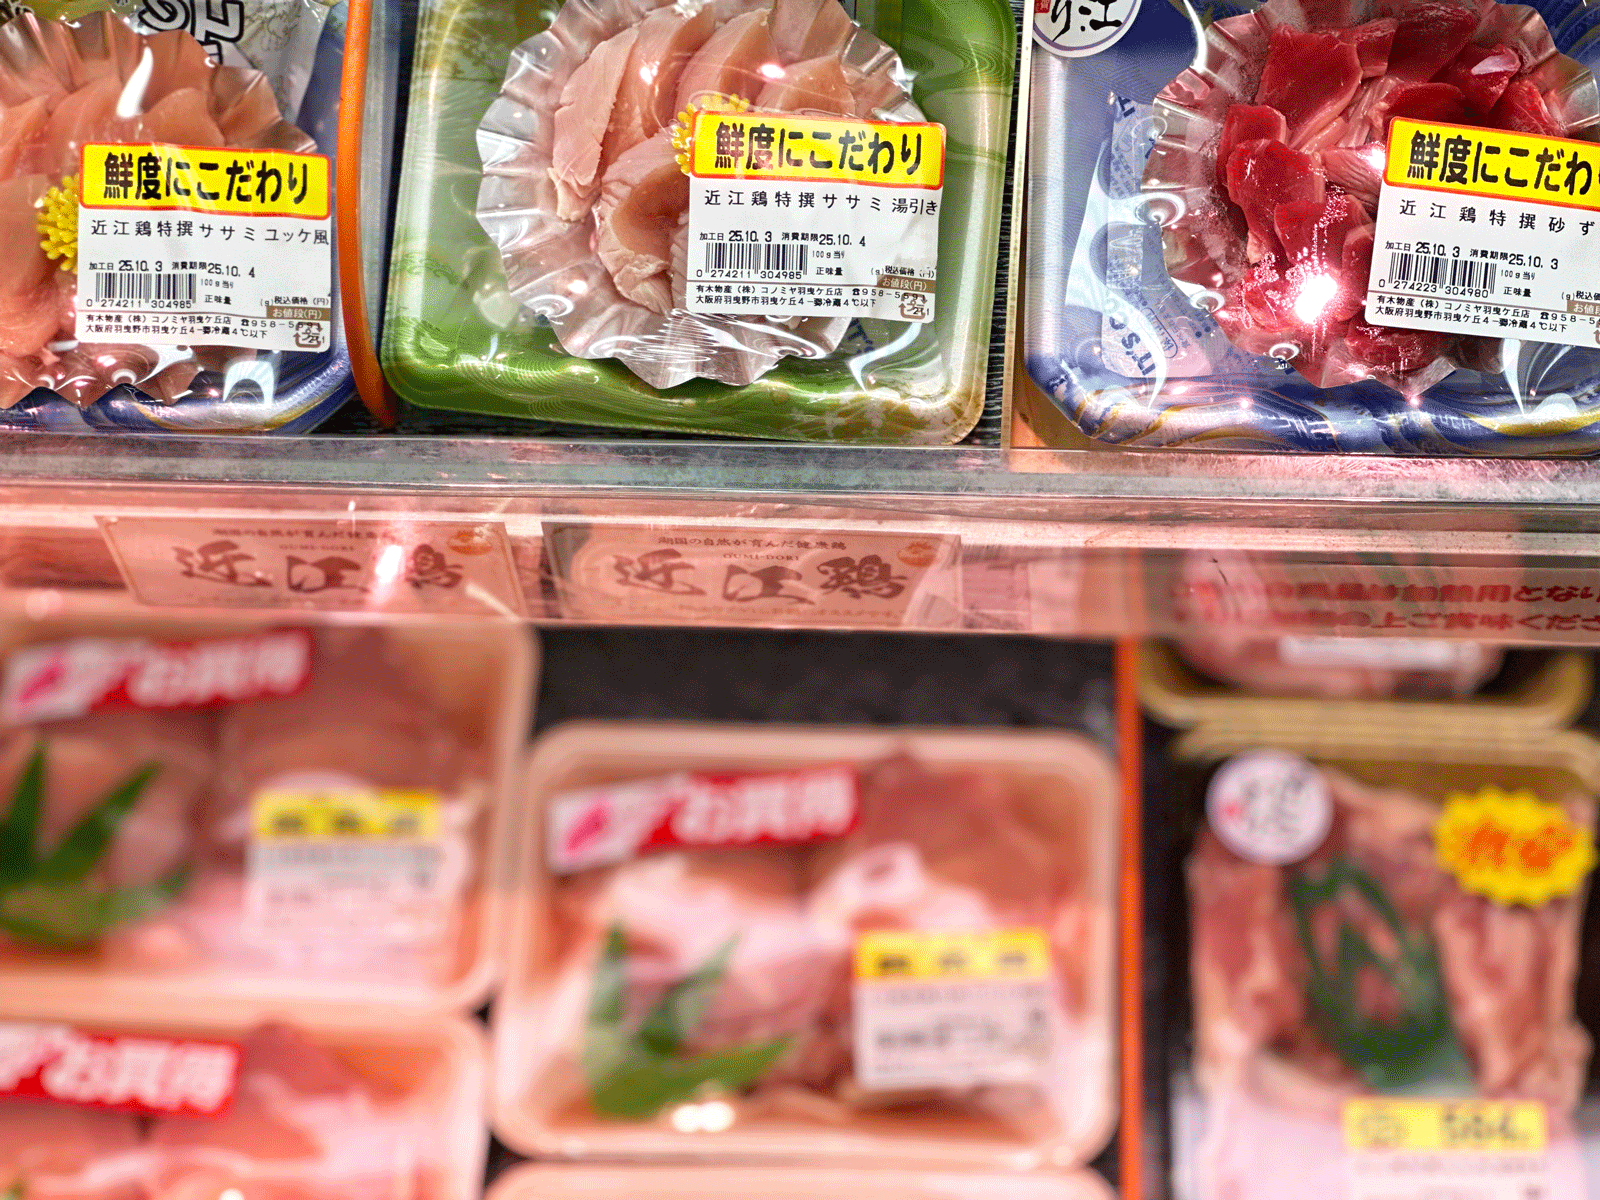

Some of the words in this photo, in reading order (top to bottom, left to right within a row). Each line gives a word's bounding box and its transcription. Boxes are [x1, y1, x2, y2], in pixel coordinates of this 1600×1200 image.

[714, 121, 922, 175] 鮮度にこだわり
[1407, 130, 1600, 196] 鮮度にこだわ
[103, 152, 309, 205] 鮮度にこだわり
[699, 232, 724, 241] 加工日
[1385, 241, 1411, 252] 加工日
[88, 262, 114, 271] 加工日
[816, 266, 843, 276] 正味量
[710, 269, 751, 279] 274211
[760, 271, 802, 280] 304985
[1393, 281, 1437, 293] 274223
[1444, 286, 1489, 299] 304980
[1503, 286, 1532, 298] 正味量
[100, 299, 142, 308] 274211
[151, 300, 192, 309] 304985
[204, 294, 232, 305] 正味量
[612, 548, 907, 606] 近江鶏
